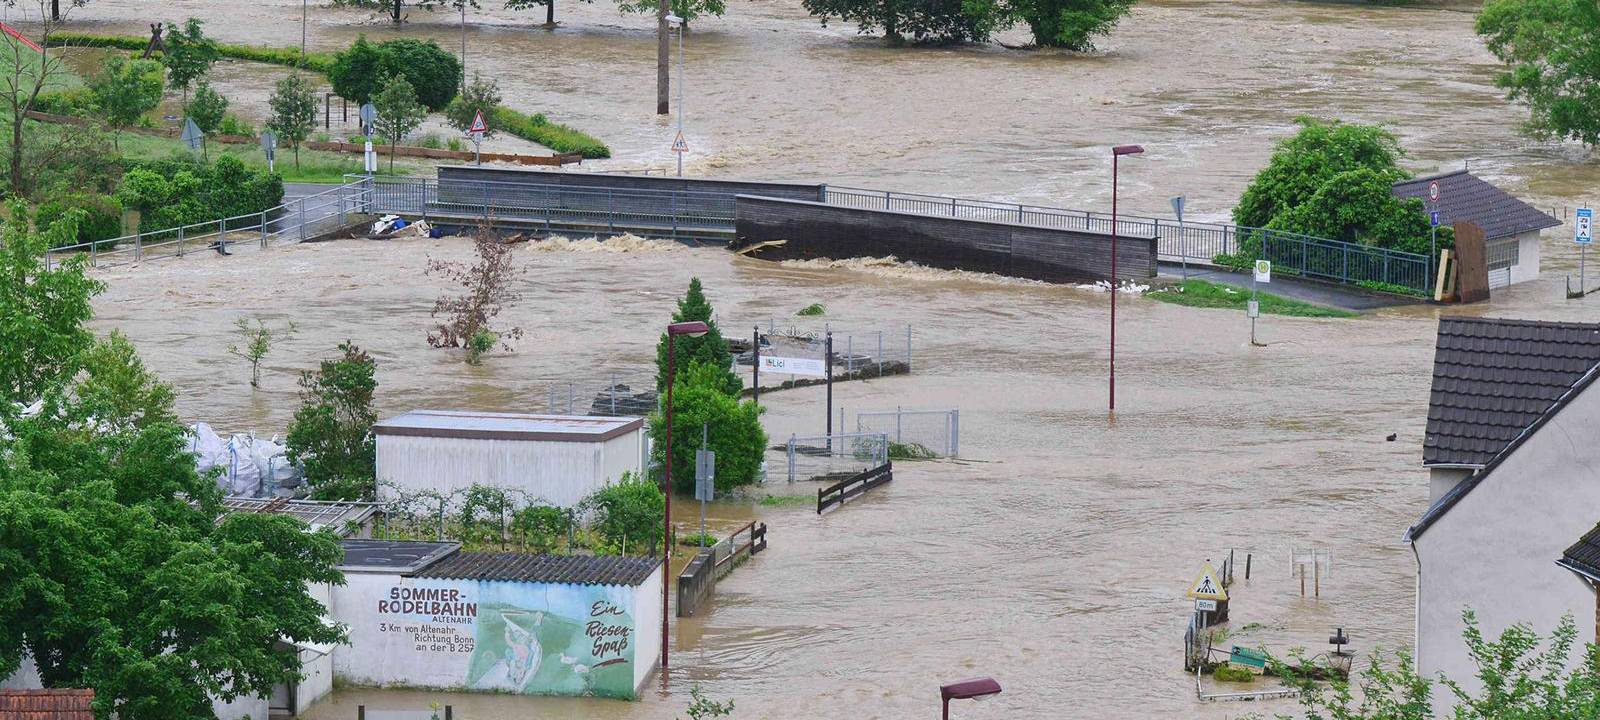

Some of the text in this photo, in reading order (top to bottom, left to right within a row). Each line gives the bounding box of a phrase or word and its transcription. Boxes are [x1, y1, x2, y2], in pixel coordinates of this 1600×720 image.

[390, 587, 466, 601] SOMMER-
[378, 600, 477, 617] RODELBAHN
[591, 600, 625, 616] Ein
[432, 615, 473, 624] ALTENAHR
[379, 623, 387, 632] 3
[389, 624, 401, 632] Km
[420, 625, 456, 634] Altenahr
[585, 620, 634, 638] Riesen-
[414, 634, 474, 645] Richtung Bonn
[430, 643, 446, 651] der
[458, 644, 474, 653] 257
[592, 636, 628, 658] Spaß
